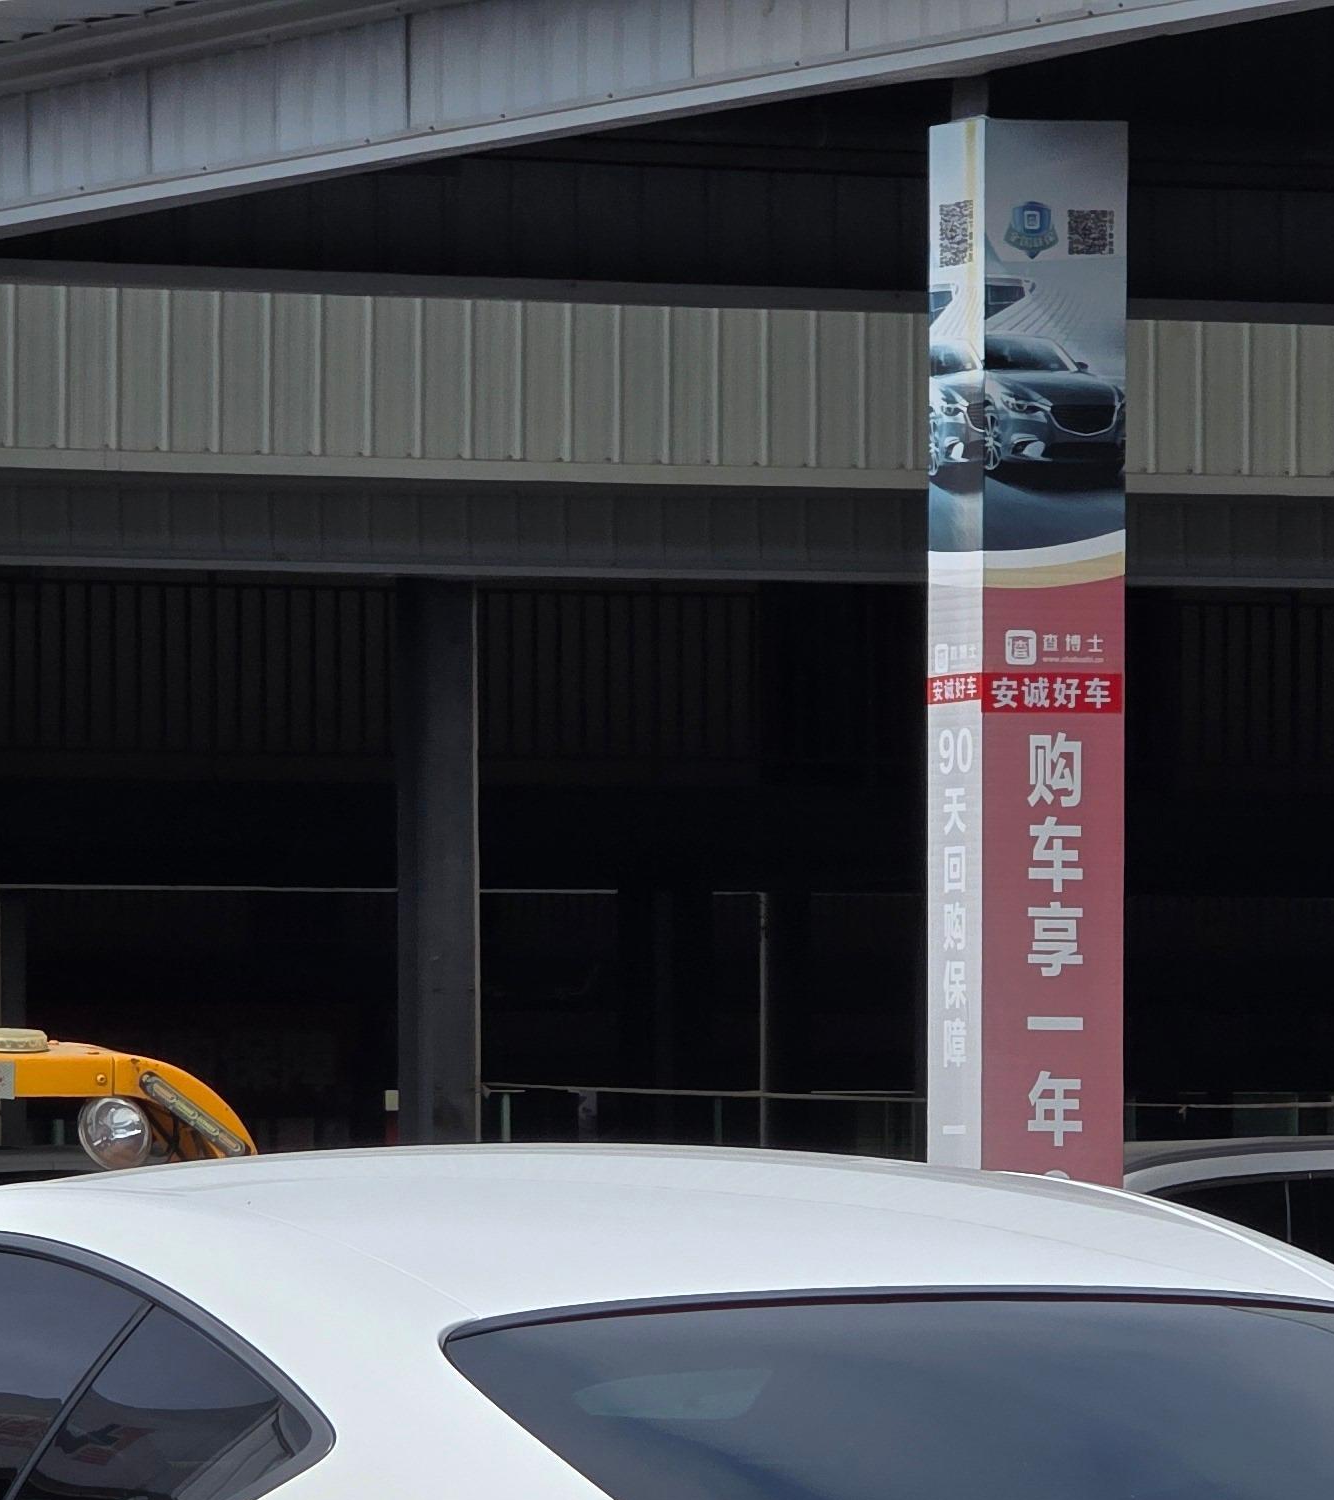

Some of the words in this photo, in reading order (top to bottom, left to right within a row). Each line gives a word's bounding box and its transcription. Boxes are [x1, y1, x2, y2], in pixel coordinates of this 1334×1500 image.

[932, 675, 978, 702] 安诚好车
[991, 676, 1112, 710] 安诚好车
[1026, 732, 1084, 1180] 购车享一年
